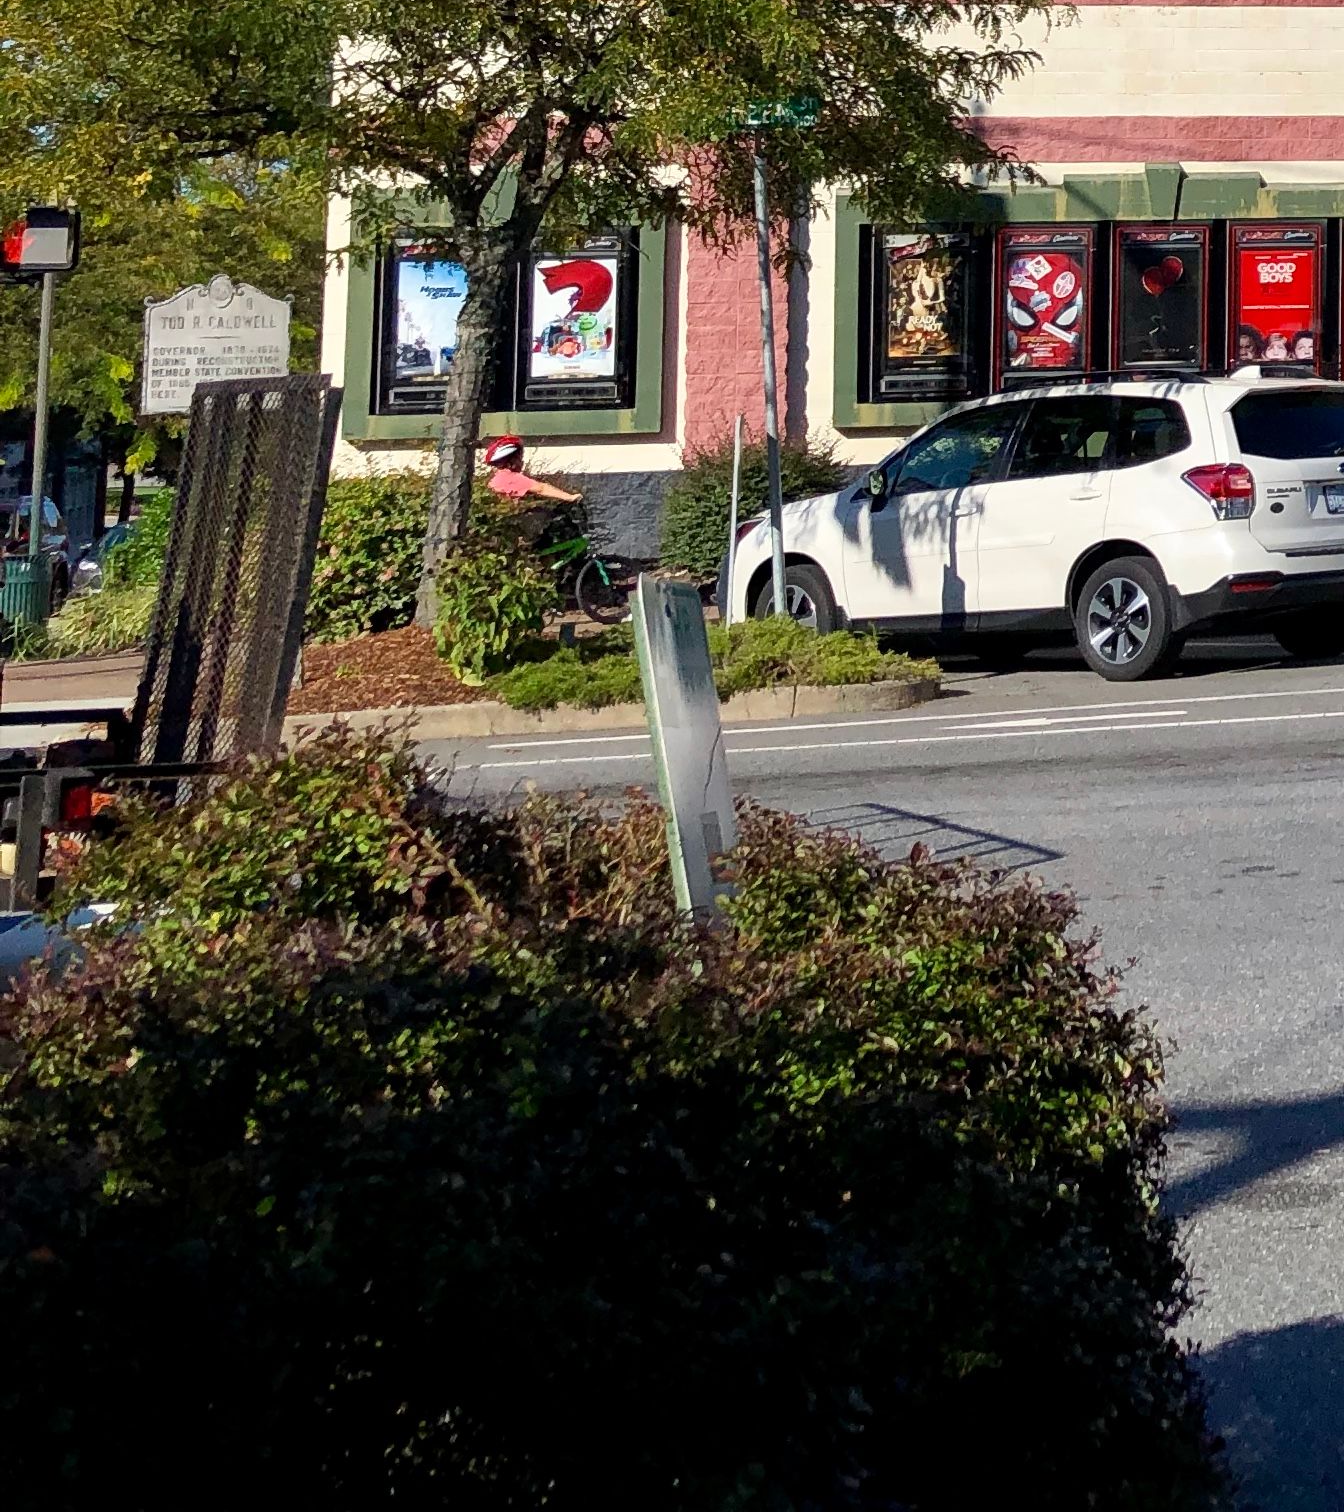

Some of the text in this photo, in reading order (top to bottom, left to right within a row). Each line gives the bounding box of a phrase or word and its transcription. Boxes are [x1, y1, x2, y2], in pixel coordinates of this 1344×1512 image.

[1257, 262, 1297, 273] GOOD
[1259, 272, 1294, 284] BOYS
[208, 314, 278, 330] CALDWELL
[909, 315, 938, 325] READY
[923, 322, 943, 332] NOT
[151, 367, 191, 378] MEMBER
[195, 366, 221, 377] STATE
